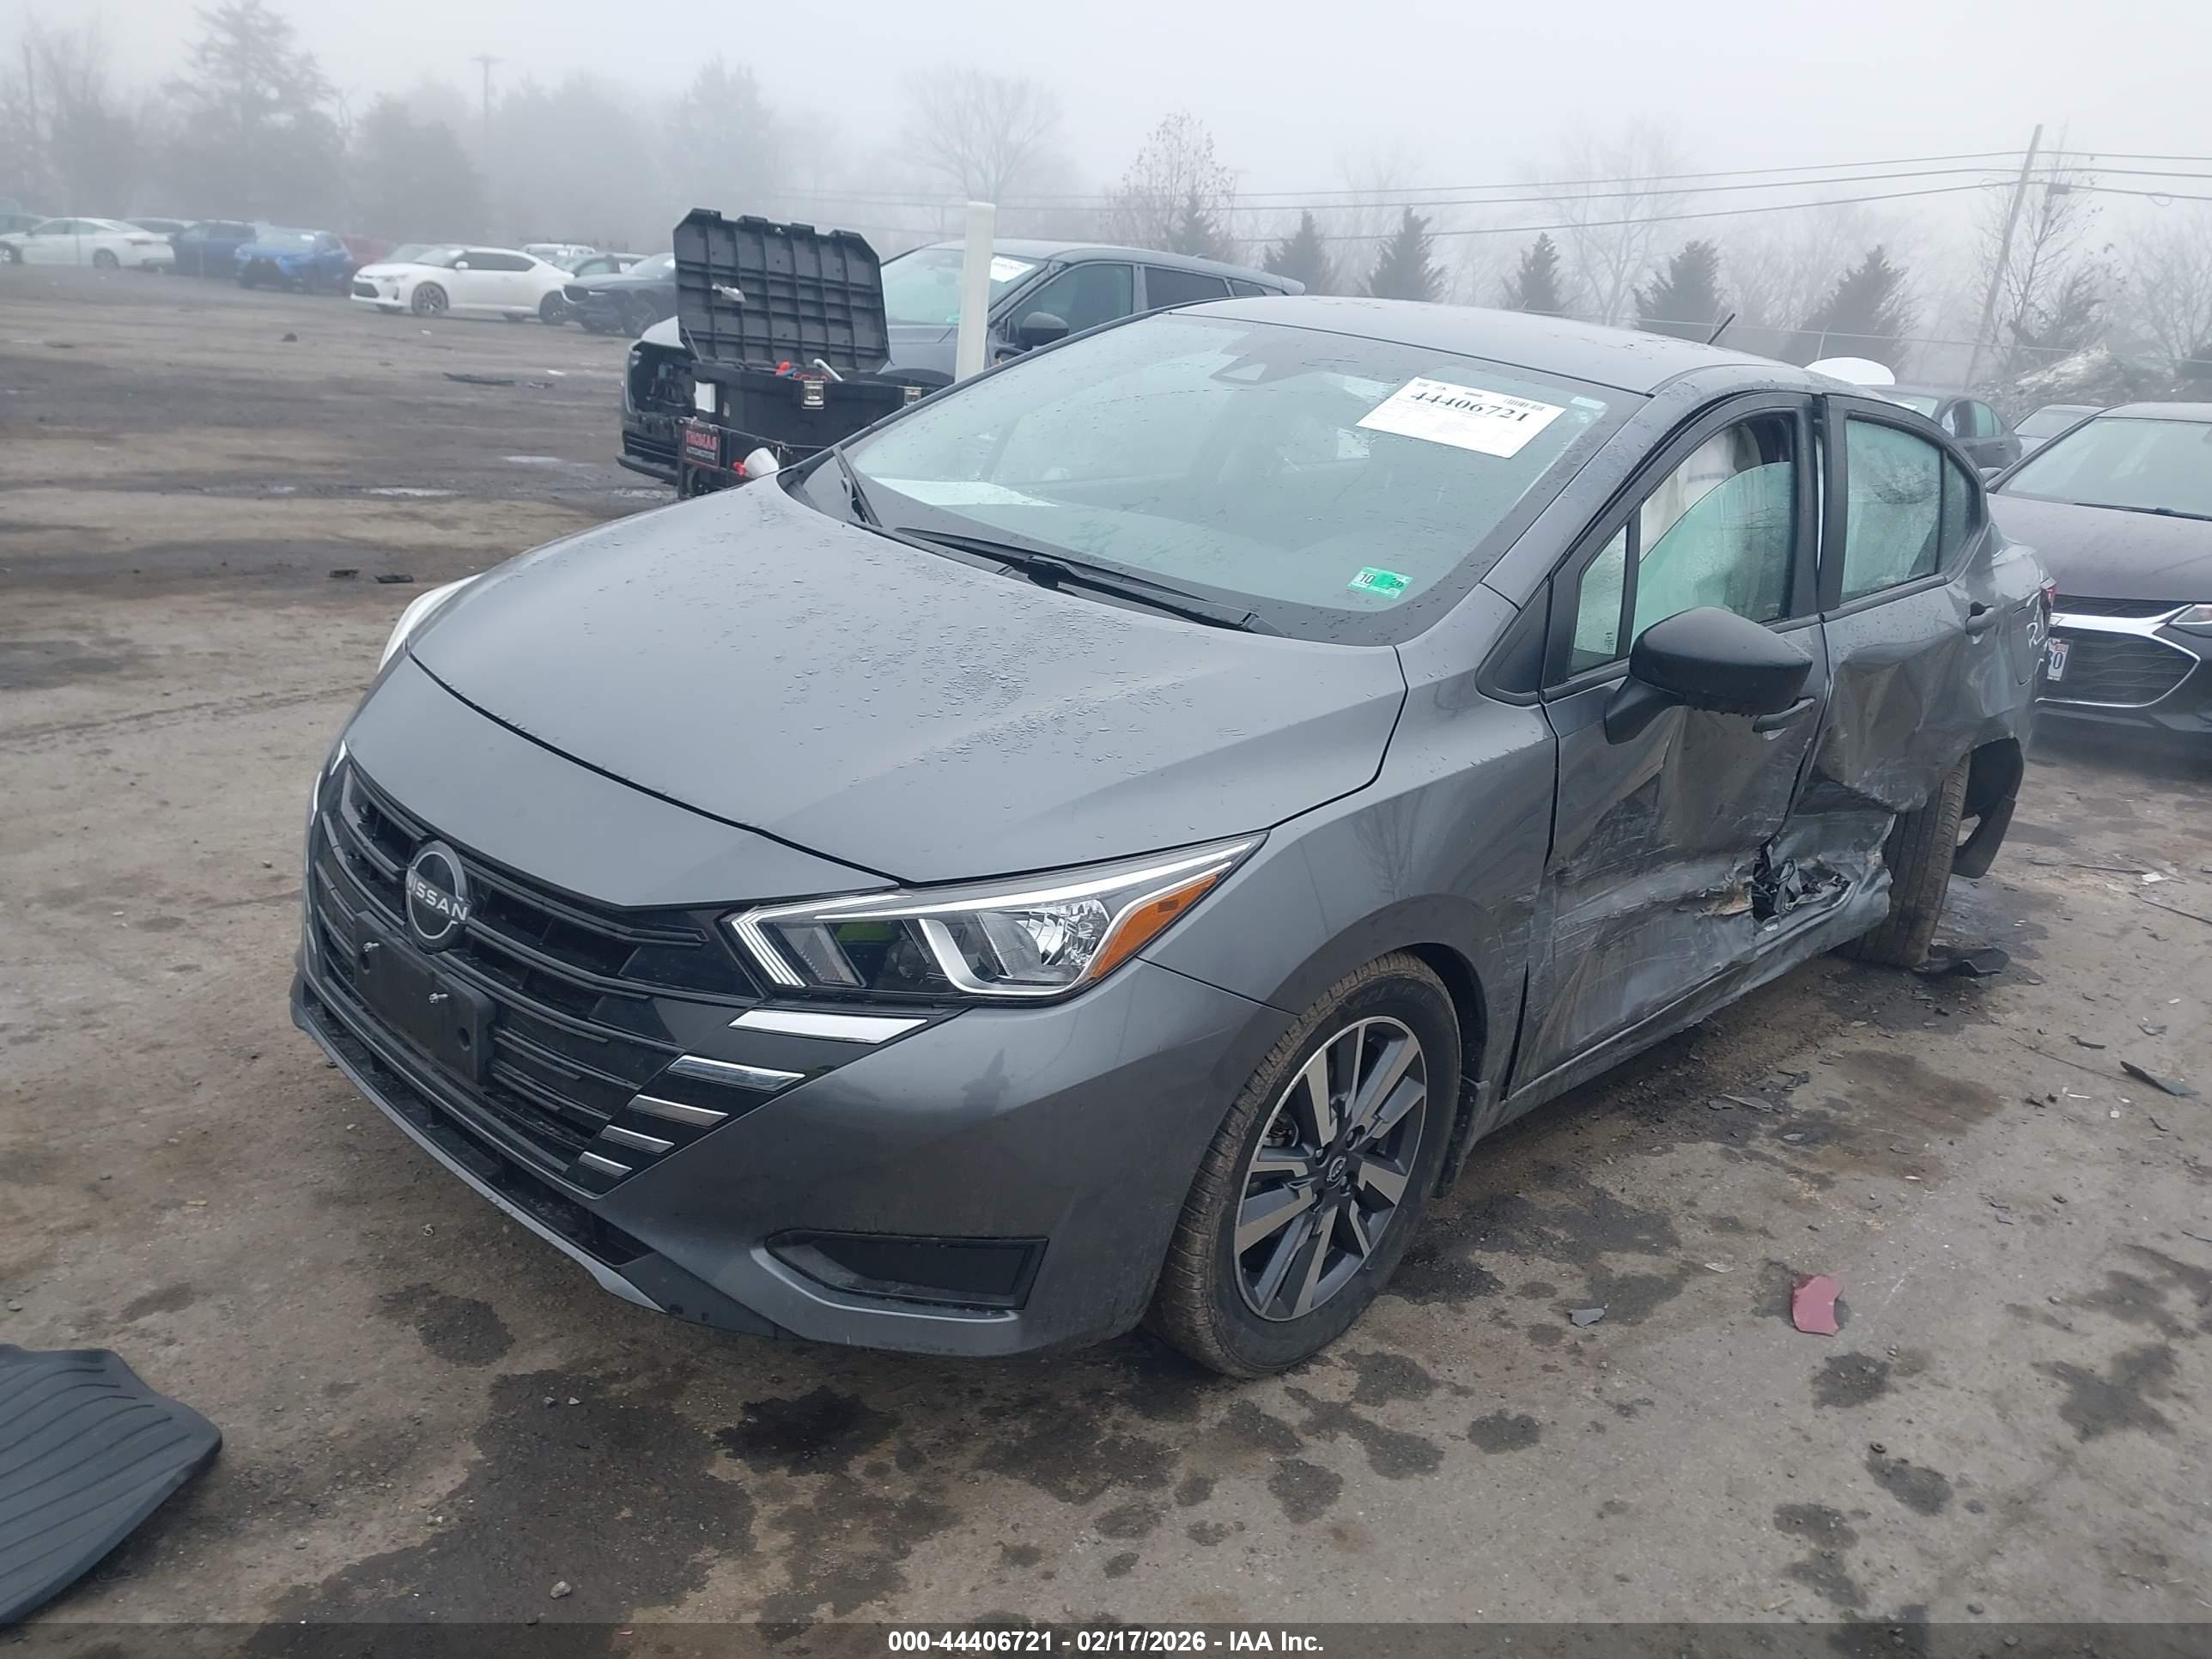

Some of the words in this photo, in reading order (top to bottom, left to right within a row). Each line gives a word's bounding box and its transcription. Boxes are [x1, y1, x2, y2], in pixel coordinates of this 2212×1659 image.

[1411, 392, 1529, 422] 44406721
[1359, 573, 1376, 585] 10
[407, 872, 468, 921] NISSAN
